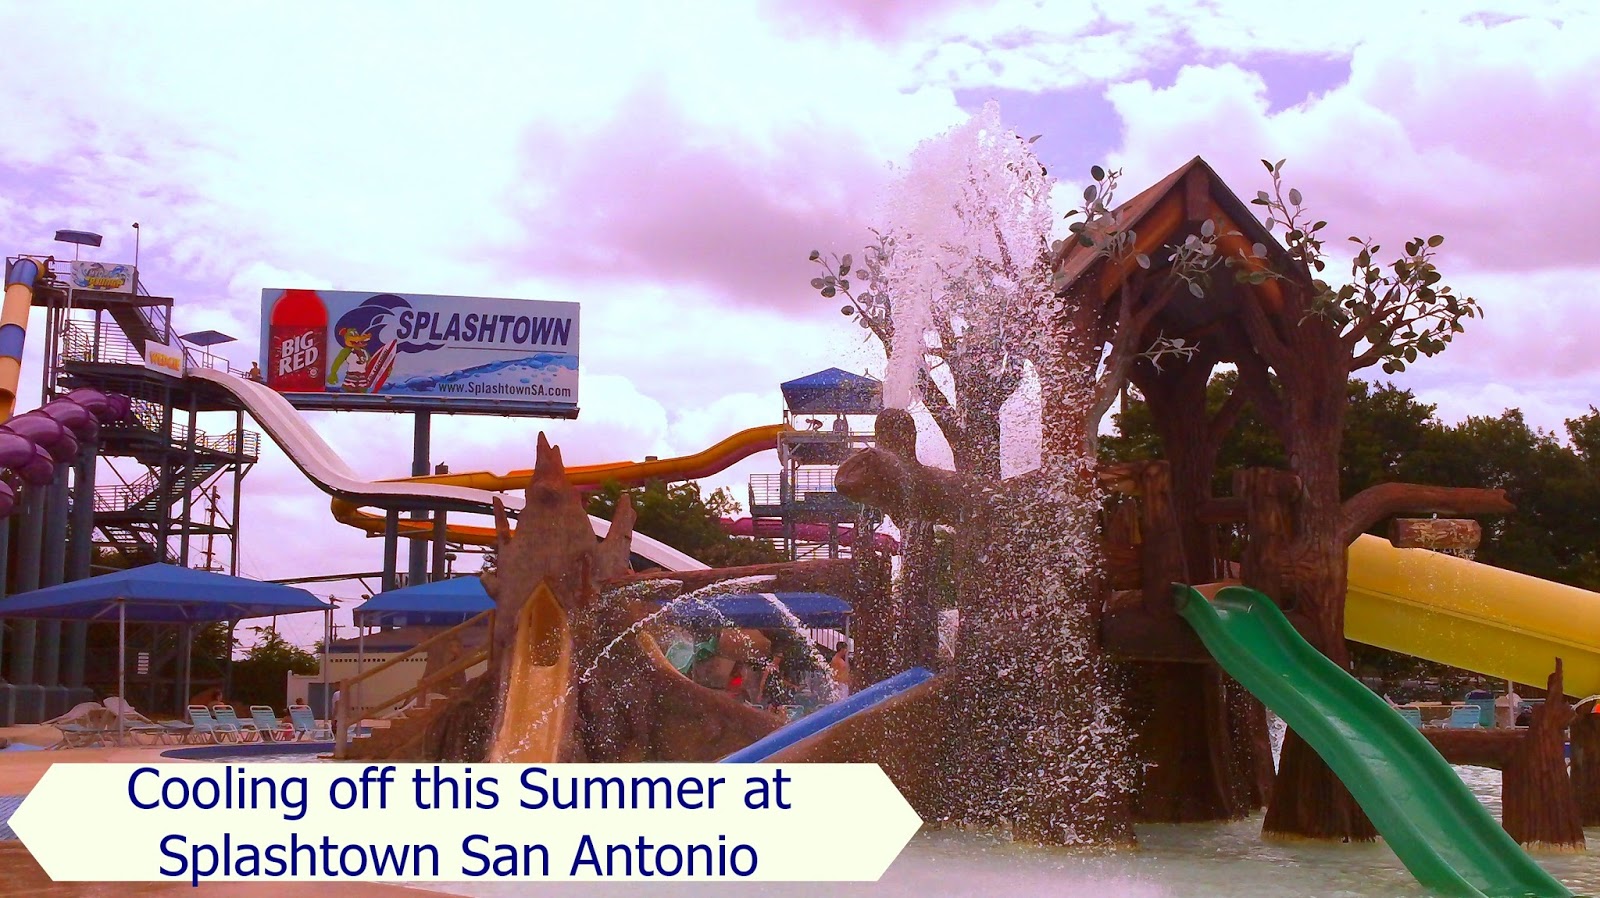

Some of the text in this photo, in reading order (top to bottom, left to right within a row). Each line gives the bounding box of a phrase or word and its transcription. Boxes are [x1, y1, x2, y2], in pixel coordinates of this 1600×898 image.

[396, 310, 572, 346] SPLASHTOWN
[281, 330, 314, 358] BIG
[278, 346, 319, 377] RED
[438, 381, 571, 397] www.SplashtownSA.com
